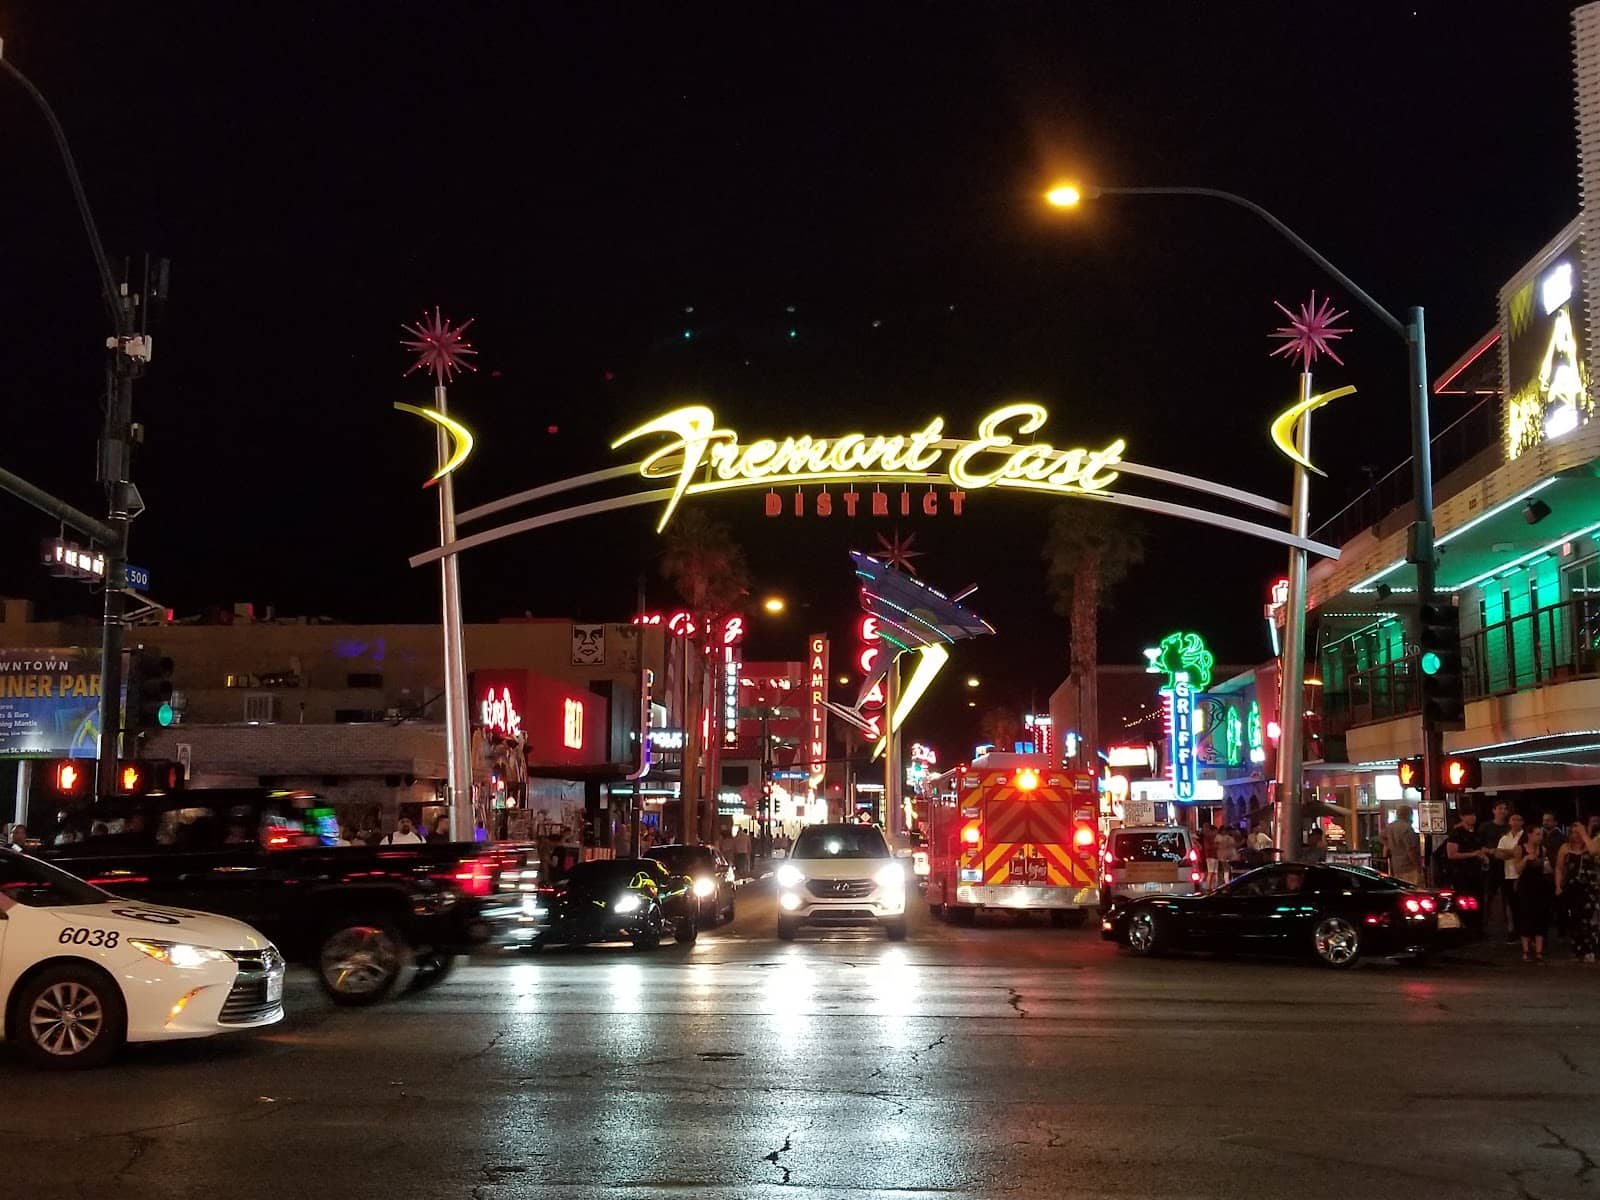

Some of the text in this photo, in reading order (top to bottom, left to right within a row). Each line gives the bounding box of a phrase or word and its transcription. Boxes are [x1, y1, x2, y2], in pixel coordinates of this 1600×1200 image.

[610, 403, 1126, 534] Fremont East
[765, 491, 966, 517] DISTRICT
[130, 570, 148, 585] 500
[810, 639, 824, 773] GAMBLING
[1175, 682, 1193, 797] GRIFFIN
[58, 927, 120, 949] 6038
